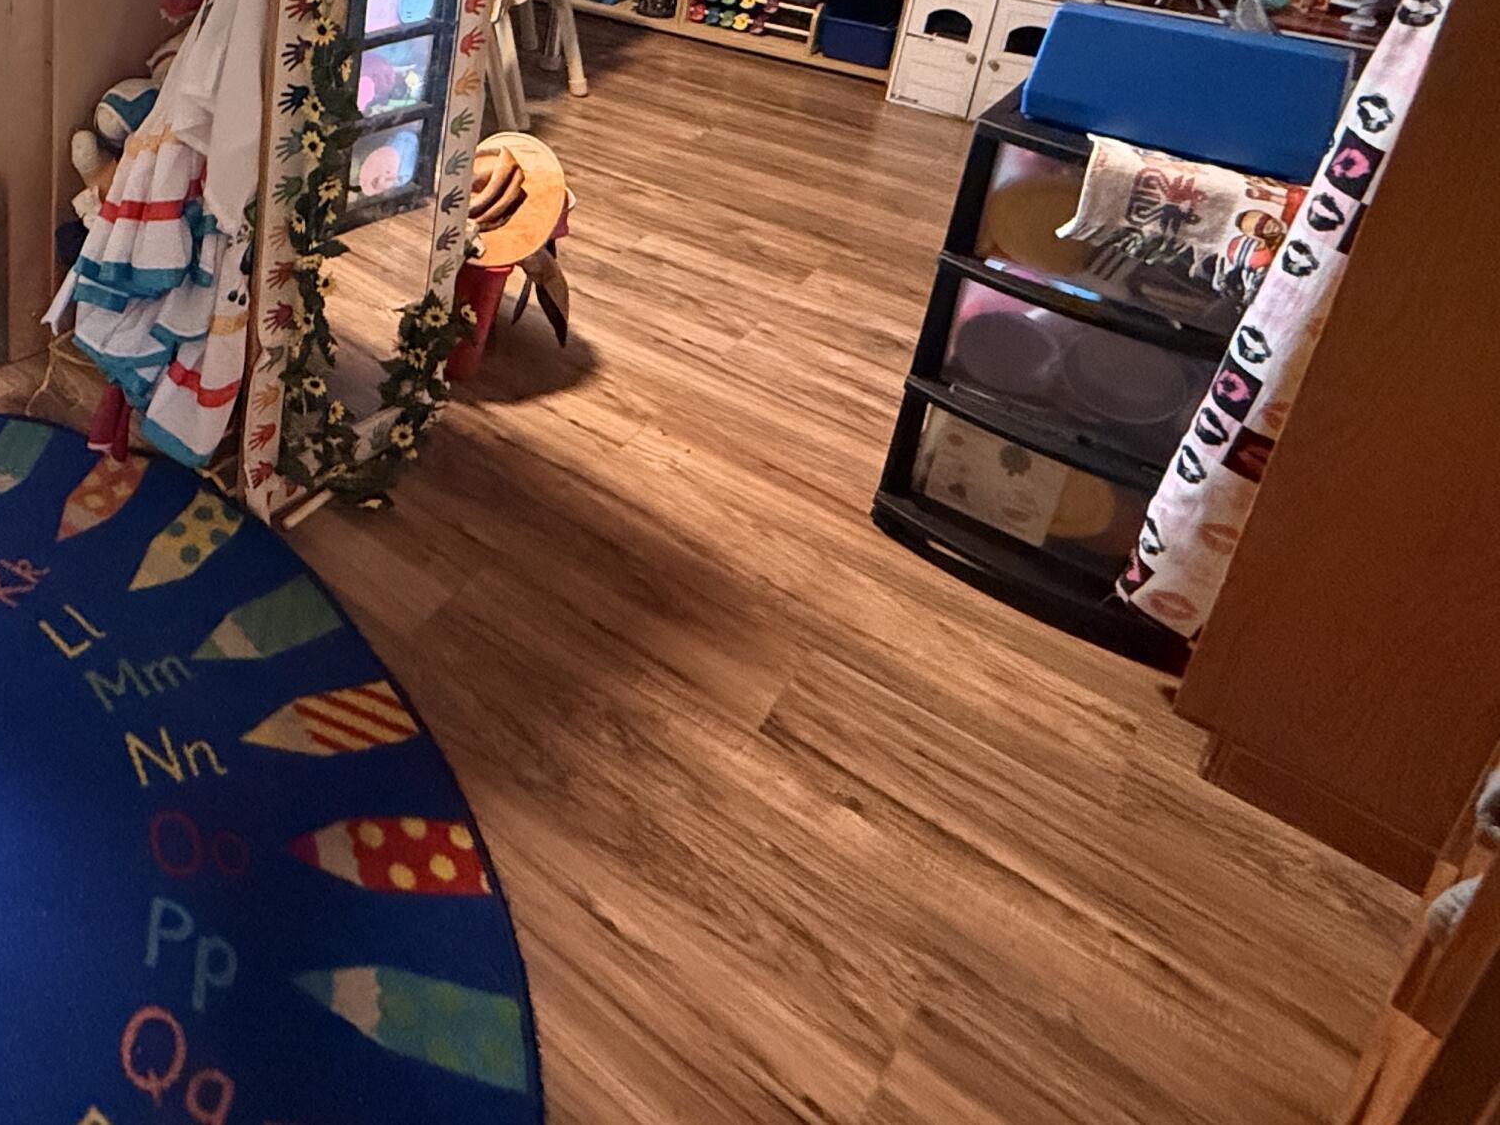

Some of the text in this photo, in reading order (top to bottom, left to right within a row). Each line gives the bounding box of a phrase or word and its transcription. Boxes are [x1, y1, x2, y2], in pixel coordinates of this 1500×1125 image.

[38, 602, 107, 659] Ll
[83, 653, 194, 712] Mm
[123, 726, 228, 788] Nn
[147, 808, 252, 878] Oo
[142, 895, 239, 1013] Pp
